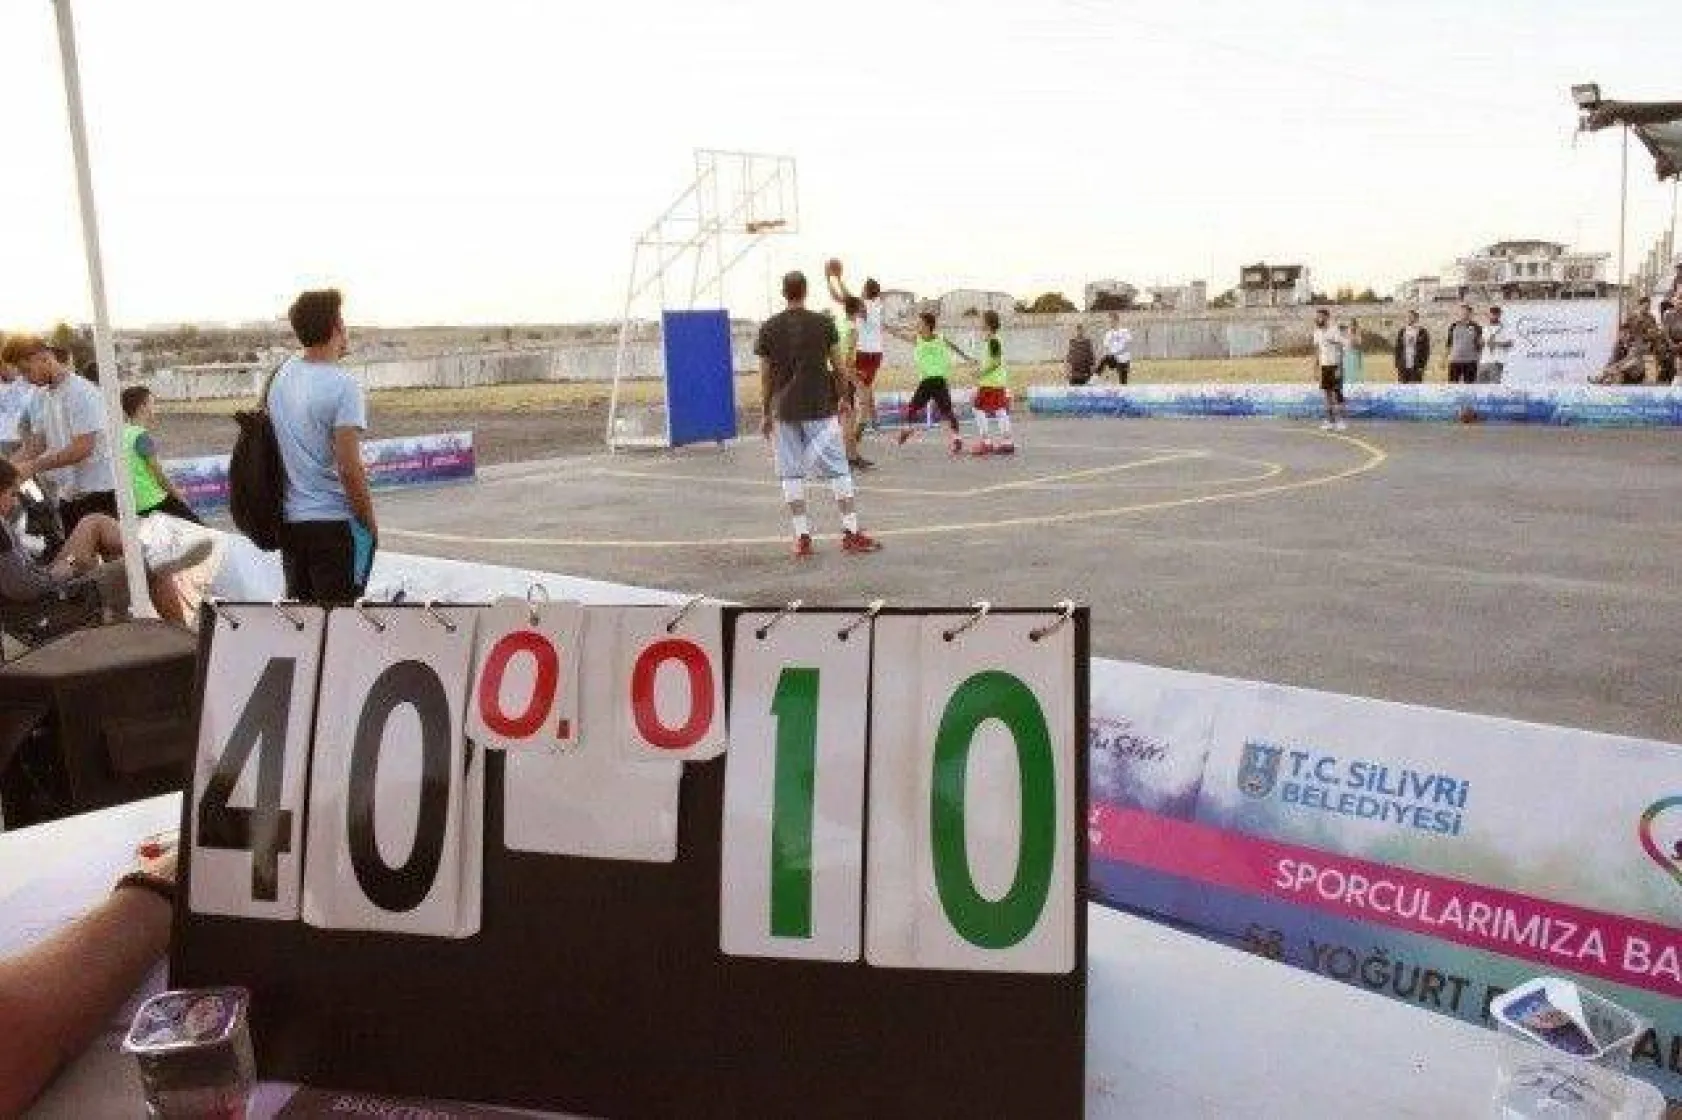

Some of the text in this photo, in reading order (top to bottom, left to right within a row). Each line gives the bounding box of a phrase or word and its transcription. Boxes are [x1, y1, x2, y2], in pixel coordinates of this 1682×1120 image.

[769, 667, 1057, 950] 10
[1289, 751, 1341, 785] T.C.
[1275, 857, 1607, 965] SPORCULARIMIZA
